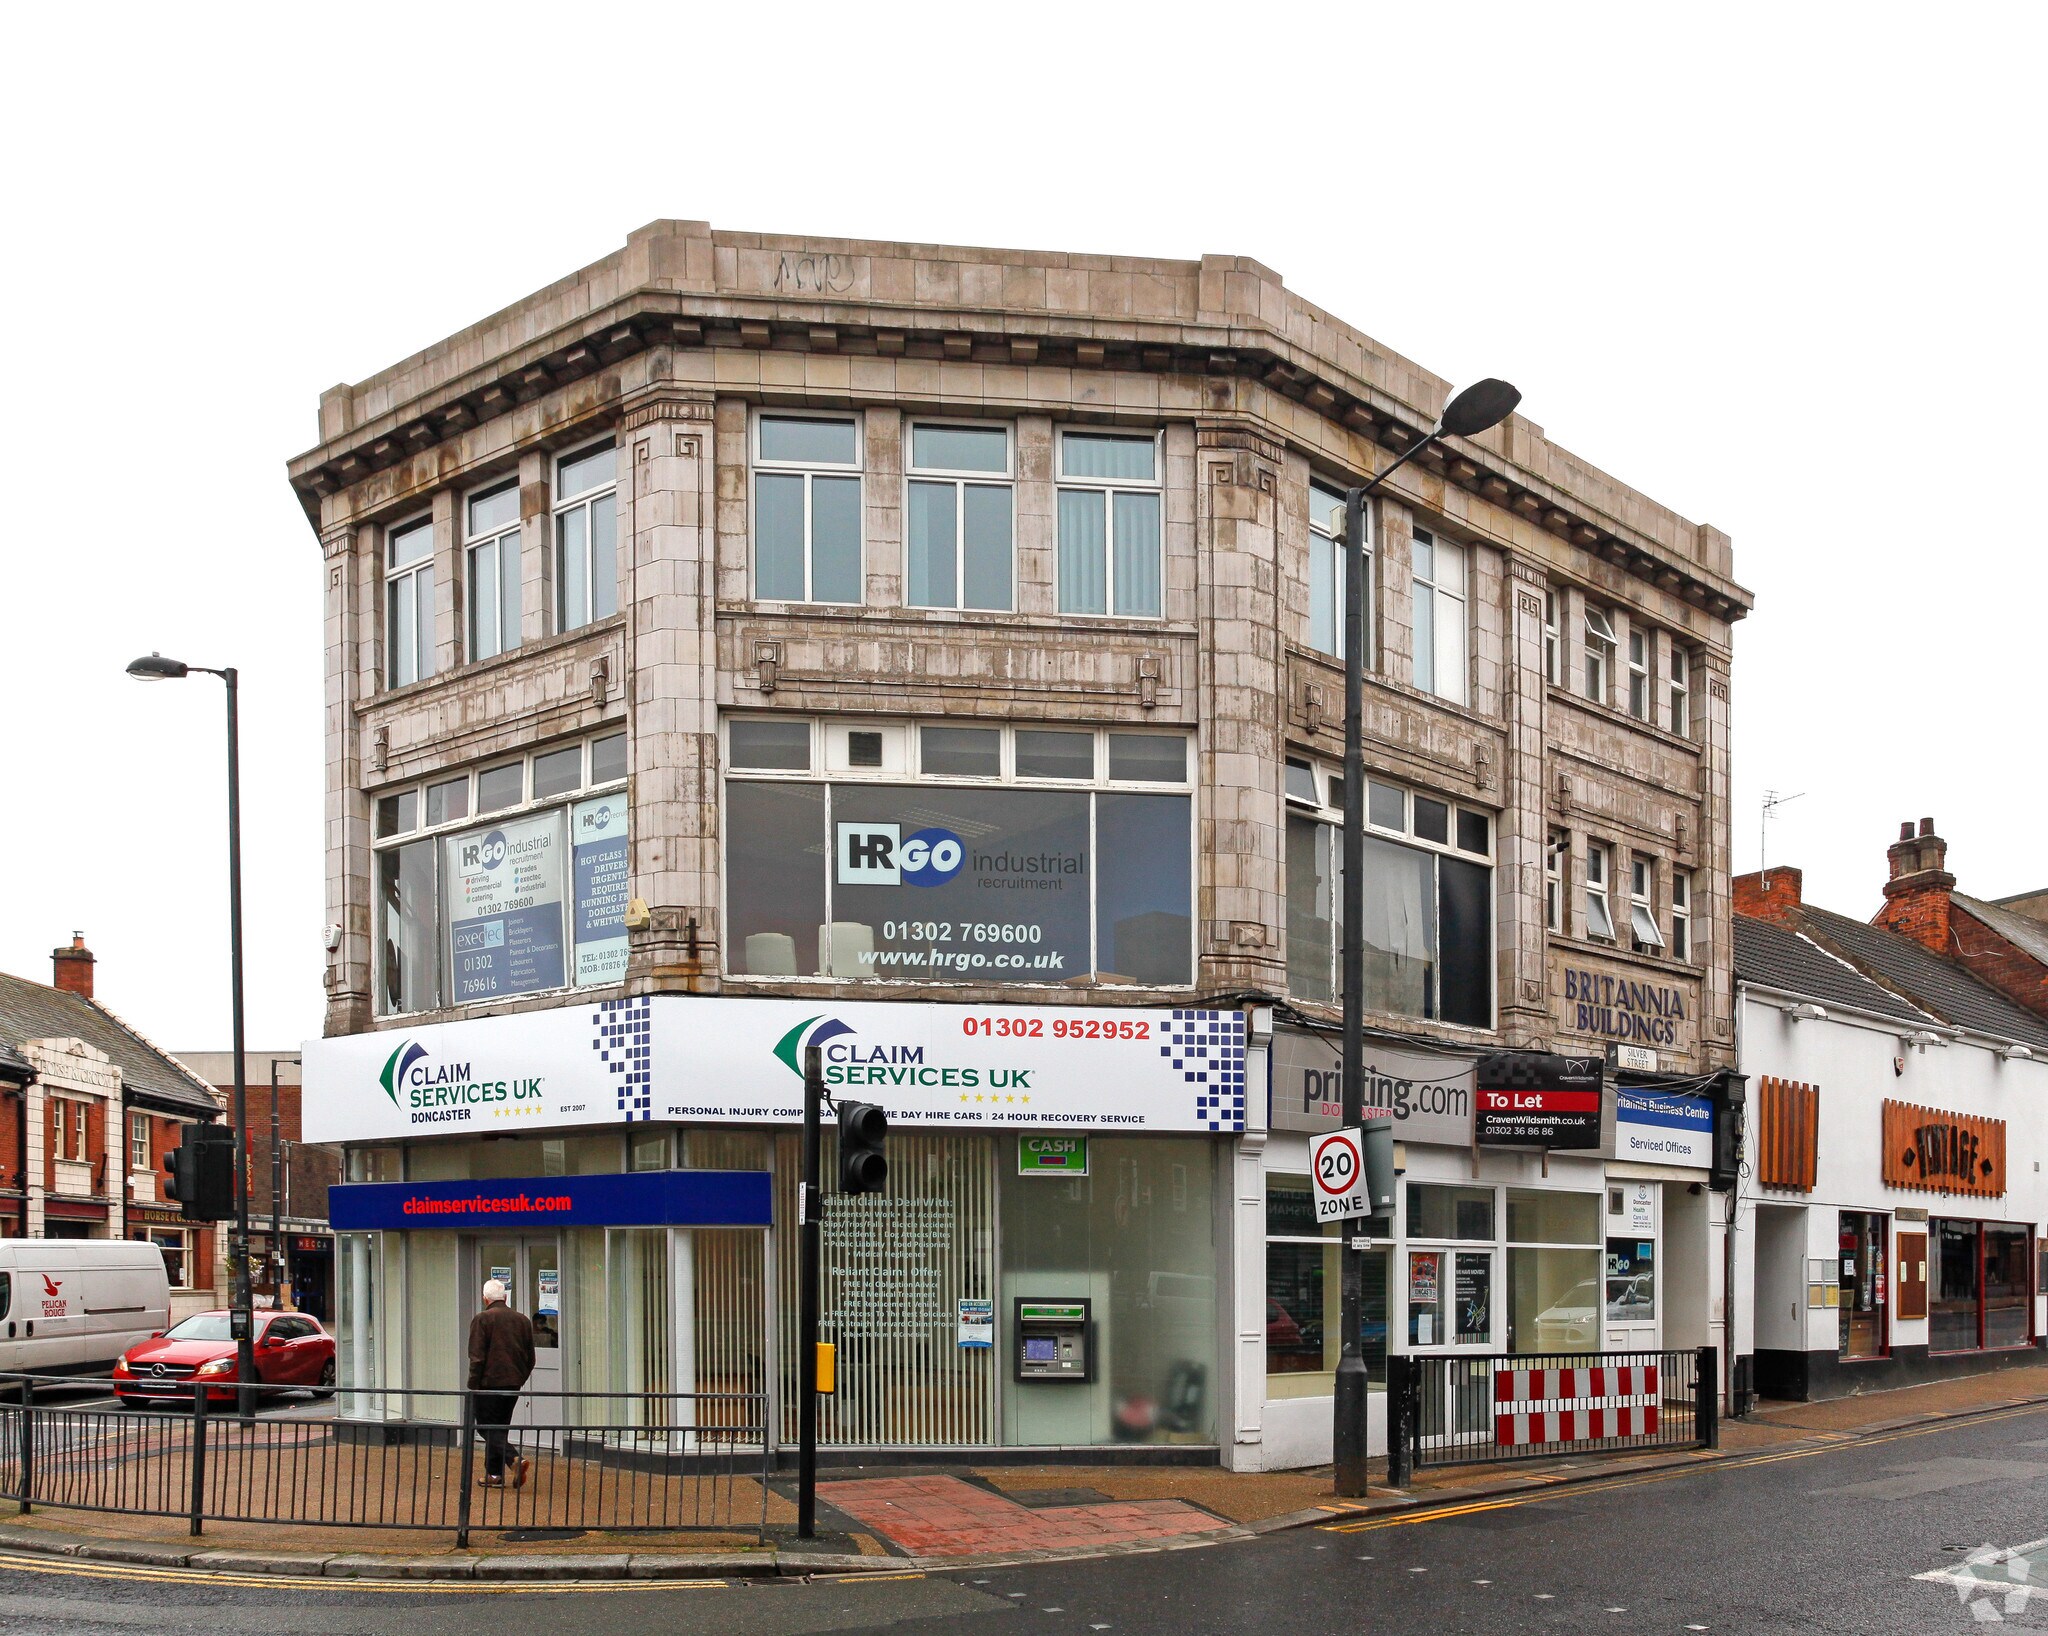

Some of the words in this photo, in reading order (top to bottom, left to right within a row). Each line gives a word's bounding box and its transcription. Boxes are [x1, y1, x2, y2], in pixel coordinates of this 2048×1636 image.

[507, 833, 552, 856] industrial
[509, 852, 544, 865] recruitment
[581, 855, 597, 866] HGV
[599, 850, 622, 862] CLASS
[973, 850, 1084, 875] industrial
[520, 864, 538, 874] trades
[594, 860, 628, 874] DRIVERS
[471, 875, 490, 885] driving
[520, 873, 542, 883] exectec
[591, 871, 628, 885] URGENTL
[977, 877, 1063, 891] recruitment
[471, 881, 503, 893] commercial
[520, 881, 547, 892] industrial
[471, 893, 494, 903] catering
[581, 895, 617, 909] RUNNING
[477, 902, 502, 916] 01302
[504, 896, 534, 911] 769600
[508, 918, 524, 927] Joiners
[586, 920, 592, 929] &
[508, 926, 534, 936] Bricklayers
[883, 920, 951, 942] 01302
[959, 922, 1042, 943] 769600
[508, 937, 532, 946] Plasterers
[531, 943, 559, 953] Decorators
[510, 958, 534, 967] Labourers
[582, 953, 598, 963] TEL:
[599, 949, 618, 960] 01302
[857, 948, 1065, 972] www.hrgo.co.uk
[464, 955, 493, 972] 01302
[580, 965, 600, 974] MOB:
[601, 961, 621, 971] 07876
[510, 967, 536, 977] Fabricators
[463, 976, 497, 994] 769616
[510, 978, 540, 987] Management
[1565, 967, 1685, 1020] BRITANNIA
[962, 1017, 1043, 1038] 01302
[1053, 1018, 1150, 1040] 952952
[1576, 1003, 1674, 1045] BUILDINGS
[827, 1044, 924, 1065] CLAIM
[1627, 1048, 1648, 1059] SILVER
[1627, 1058, 1649, 1069] STREET
[410, 1062, 471, 1087] CLAIM
[826, 1065, 979, 1087] SERVICES
[989, 1068, 1032, 1088] UK
[409, 1081, 507, 1109] SERVICES
[513, 1078, 543, 1100] UK
[1304, 1060, 1468, 1120] priting.com
[1487, 1092, 1509, 1109] To
[1513, 1092, 1543, 1109] Let
[411, 1108, 471, 1124] DONCASTER
[560, 1105, 572, 1113] EST
[572, 1104, 586, 1112] 2007
[668, 1106, 726, 1116] PERSONAL
[729, 1107, 770, 1117] INJURY
[772, 1108, 838, 1117] COMPSAT
[901, 1111, 922, 1119] DAY
[925, 1111, 951, 1120] HIRE
[954, 1111, 982, 1120] CARS
[991, 1112, 1005, 1121] 24
[1007, 1112, 1038, 1122] HOUR
[1041, 1113, 1098, 1123] RECOVERY
[1100, 1114, 1146, 1124] SERVICE
[1321, 1102, 1393, 1121] DOASTER
[1648, 1100, 1684, 1116] Business
[1685, 1105, 1710, 1120] Centre
[1486, 1115, 1586, 1126] CravenWildsmith.co.uk
[1485, 1126, 1512, 1135] 01302
[1514, 1127, 1526, 1136] 36
[1527, 1127, 1540, 1136] 86
[1541, 1127, 1554, 1136] 86
[1028, 1140, 1076, 1153] CASH
[1630, 1137, 1665, 1152] Serviced
[1666, 1141, 1692, 1155] Offices
[1321, 1152, 1352, 1179] 20
[402, 1193, 573, 1215] claimservicesuk.com
[822, 1198, 855, 1207] eliant
[1320, 1196, 1364, 1215] ZONE
[1633, 1198, 1652, 1206] Doncaster
[144, 1210, 170, 1221] HORSE
[170, 1214, 177, 1222] &
[299, 1239, 327, 1248] MECCA
[832, 1267, 870, 1276] Reliant
[42, 1300, 67, 1309] PELICAN
[44, 1309, 66, 1317] ROUGE
